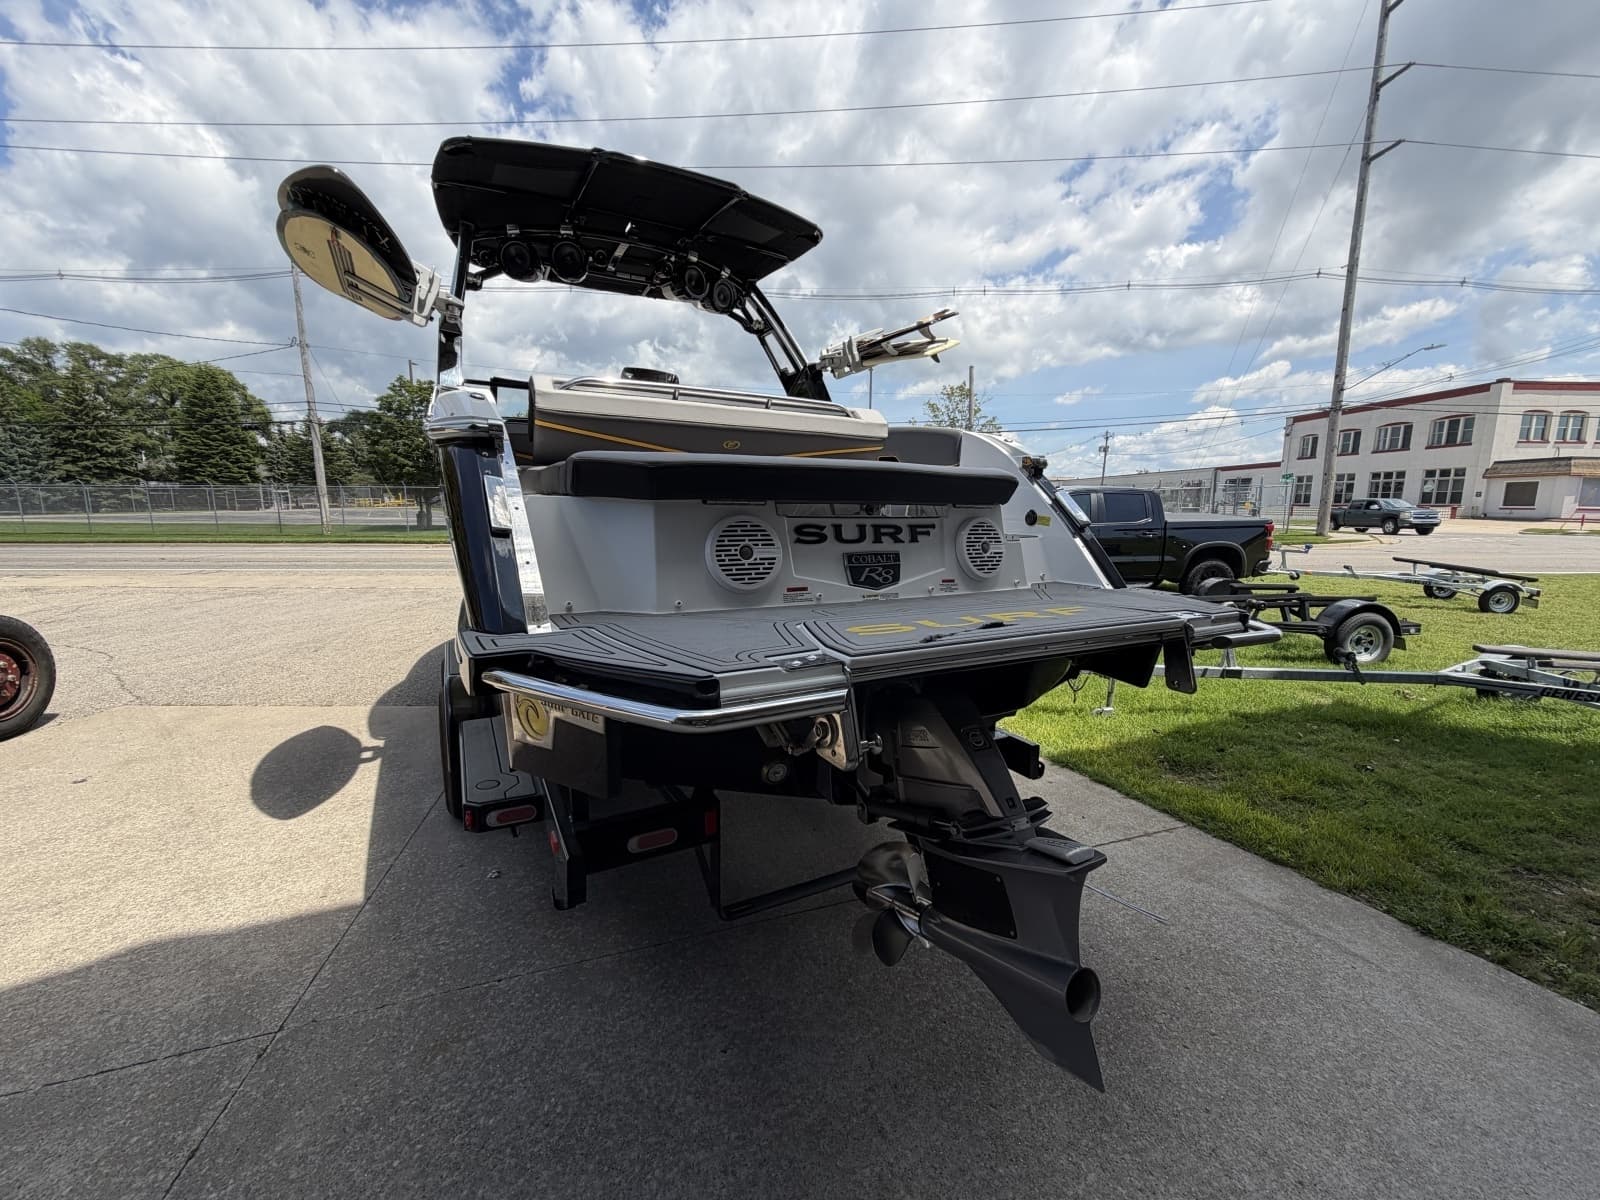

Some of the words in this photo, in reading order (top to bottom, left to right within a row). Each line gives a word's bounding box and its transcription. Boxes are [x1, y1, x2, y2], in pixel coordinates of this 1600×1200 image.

[793, 523, 936, 545] SURF
[852, 553, 897, 564] COBALT
[860, 566, 895, 584] R8
[847, 606, 1087, 636] SURF
